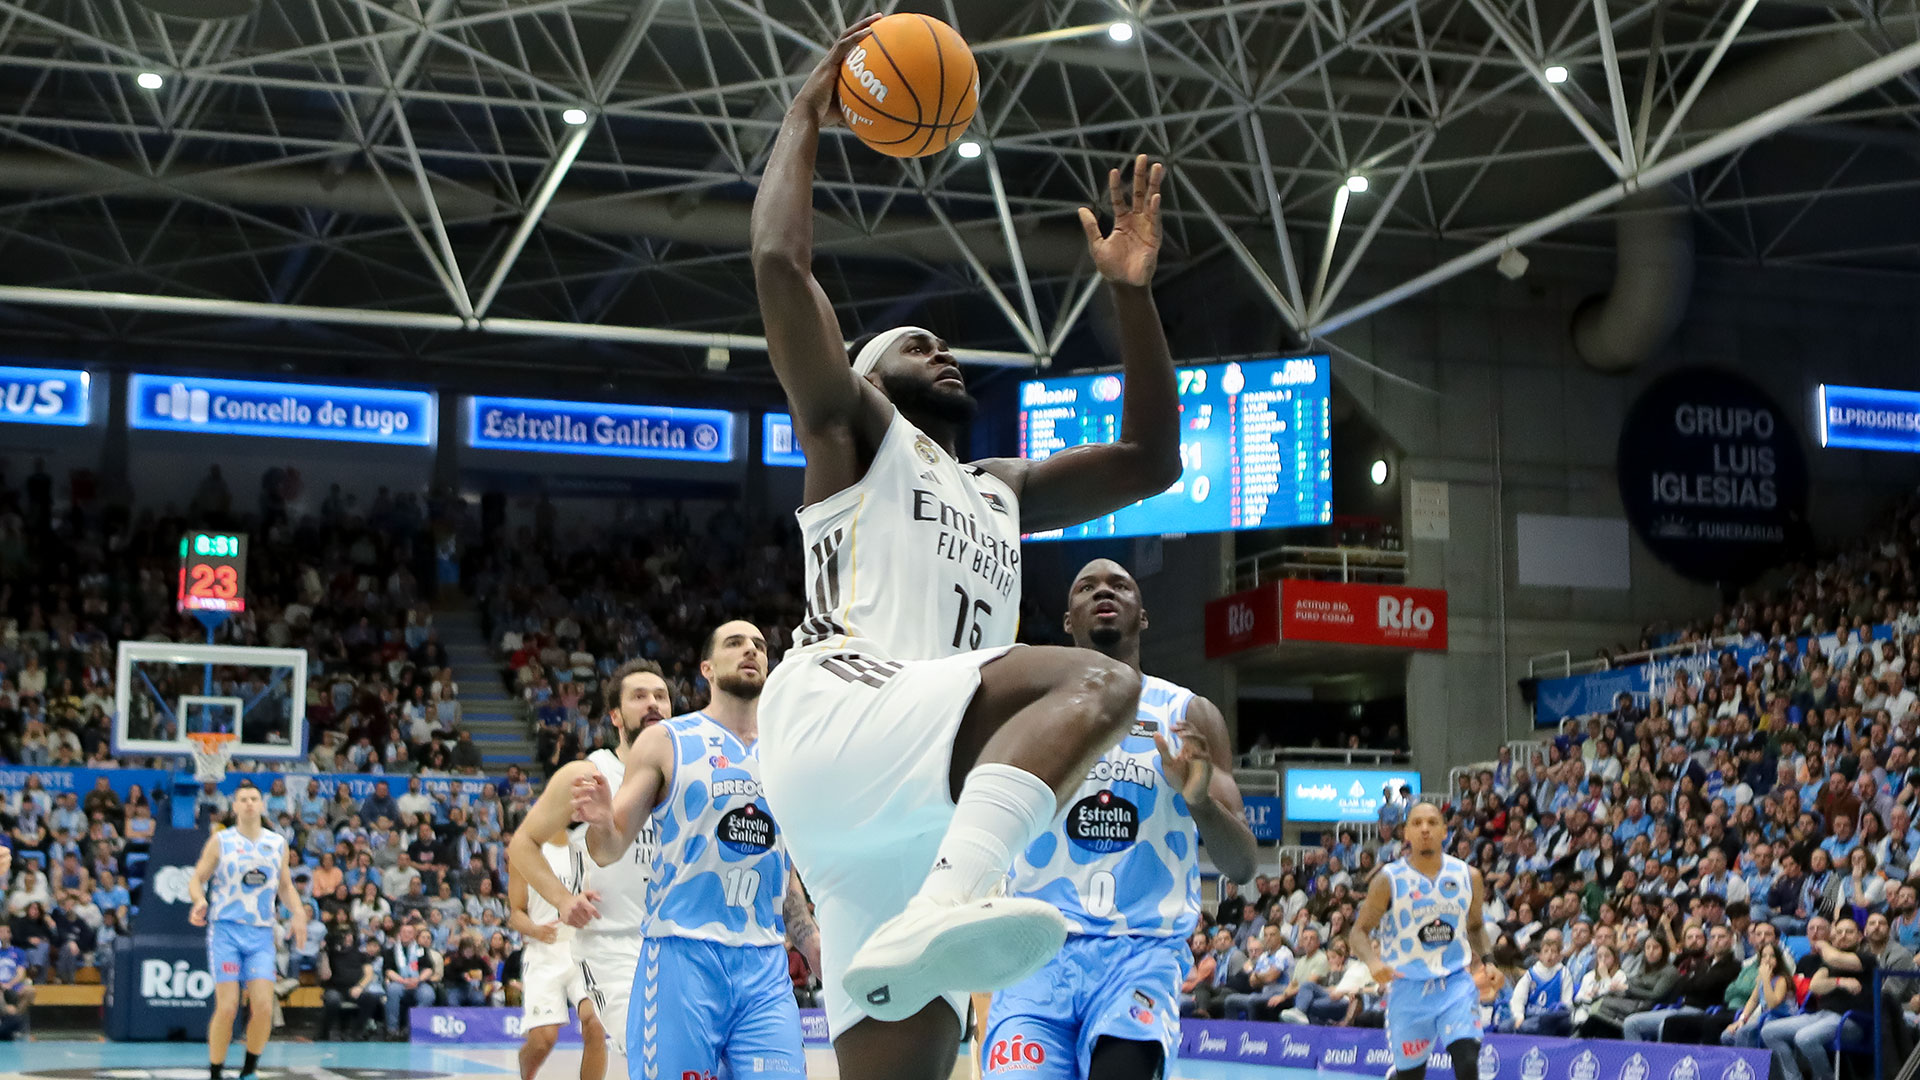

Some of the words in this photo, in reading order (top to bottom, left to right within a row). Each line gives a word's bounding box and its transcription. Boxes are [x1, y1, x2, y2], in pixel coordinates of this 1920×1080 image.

[846, 44, 889, 103] ilson
[0, 380, 67, 415] US
[213, 395, 312, 425] Concello
[317, 400, 348, 426] de
[353, 404, 409, 434] Lugo
[483, 409, 588, 443] Estrella
[594, 415, 686, 448] Galicia
[1675, 403, 1774, 440] GRUPO
[1714, 443, 1776, 477] LUIS
[1652, 472, 1778, 508] IGLESIAS
[937, 531, 968, 564] FLY
[190, 563, 239, 599] 23
[1378, 595, 1435, 632] Río
[1085, 757, 1155, 791] OGÁN
[727, 813, 769, 833] Estrella
[1078, 805, 1132, 823] Estrella
[1078, 822, 1130, 838] Galicia
[728, 827, 767, 845] Galicia
[725, 867, 762, 908] 10
[1088, 870, 1117, 918] 0
[140, 958, 215, 1000] Río
[431, 1015, 467, 1035] Río
[989, 1033, 1046, 1072] Río
[1324, 1046, 1358, 1064] arenal
[1366, 1049, 1394, 1064] arena
